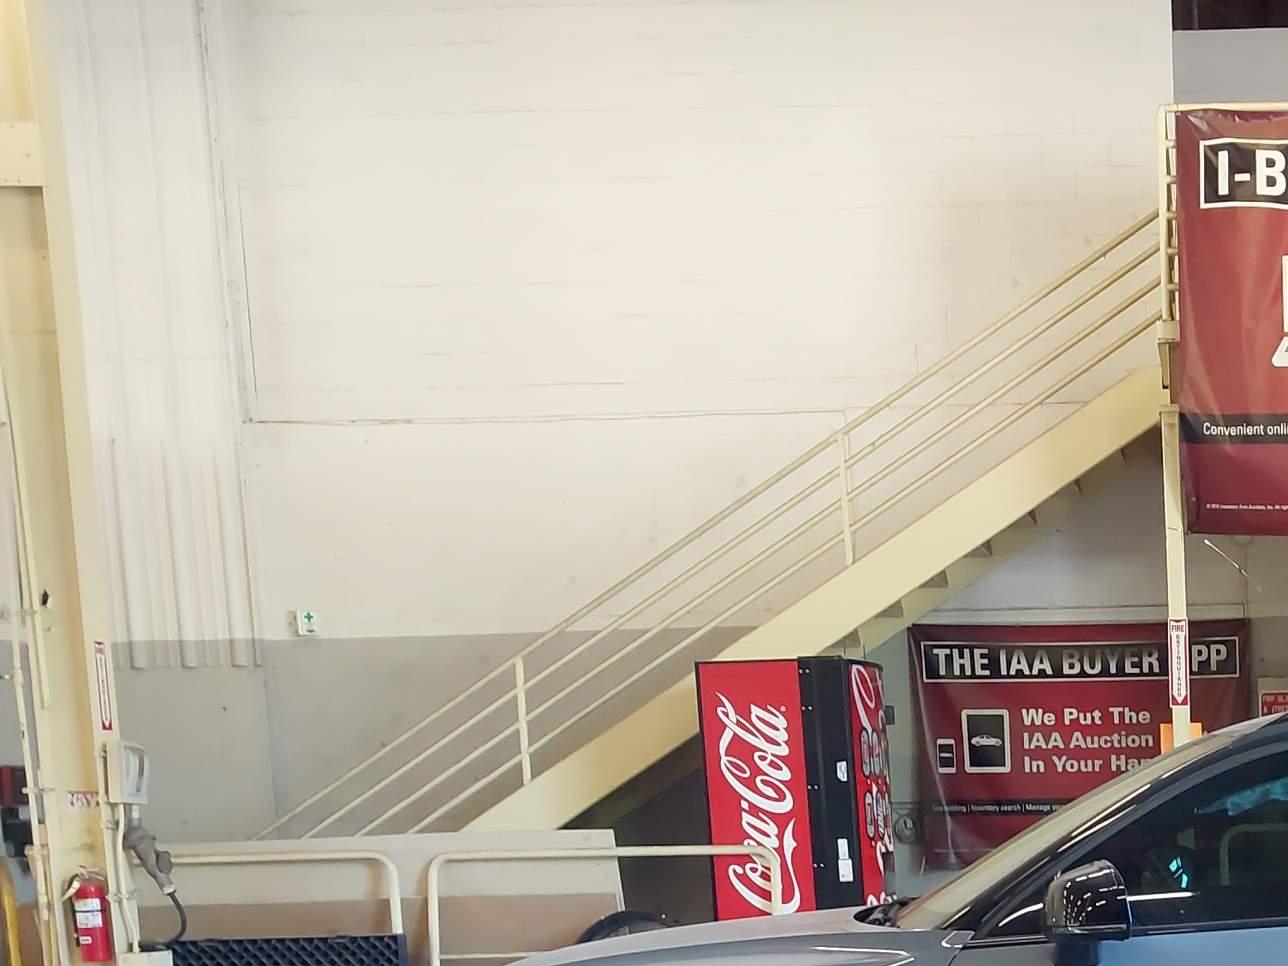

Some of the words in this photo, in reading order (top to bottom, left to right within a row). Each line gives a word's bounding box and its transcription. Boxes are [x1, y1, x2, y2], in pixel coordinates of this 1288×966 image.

[1203, 422, 1264, 436] Convenient
[932, 648, 990, 676] THE
[999, 648, 1053, 676] IAA
[1062, 648, 1160, 675] BUYER
[1191, 644, 1228, 672] PP
[1021, 708, 1056, 726] We
[1063, 707, 1102, 725] Put
[1109, 706, 1151, 724] The
[1023, 732, 1065, 749] IAA
[1069, 731, 1154, 749] Auction
[1024, 755, 1045, 773] In
[1051, 755, 1103, 773] Your
